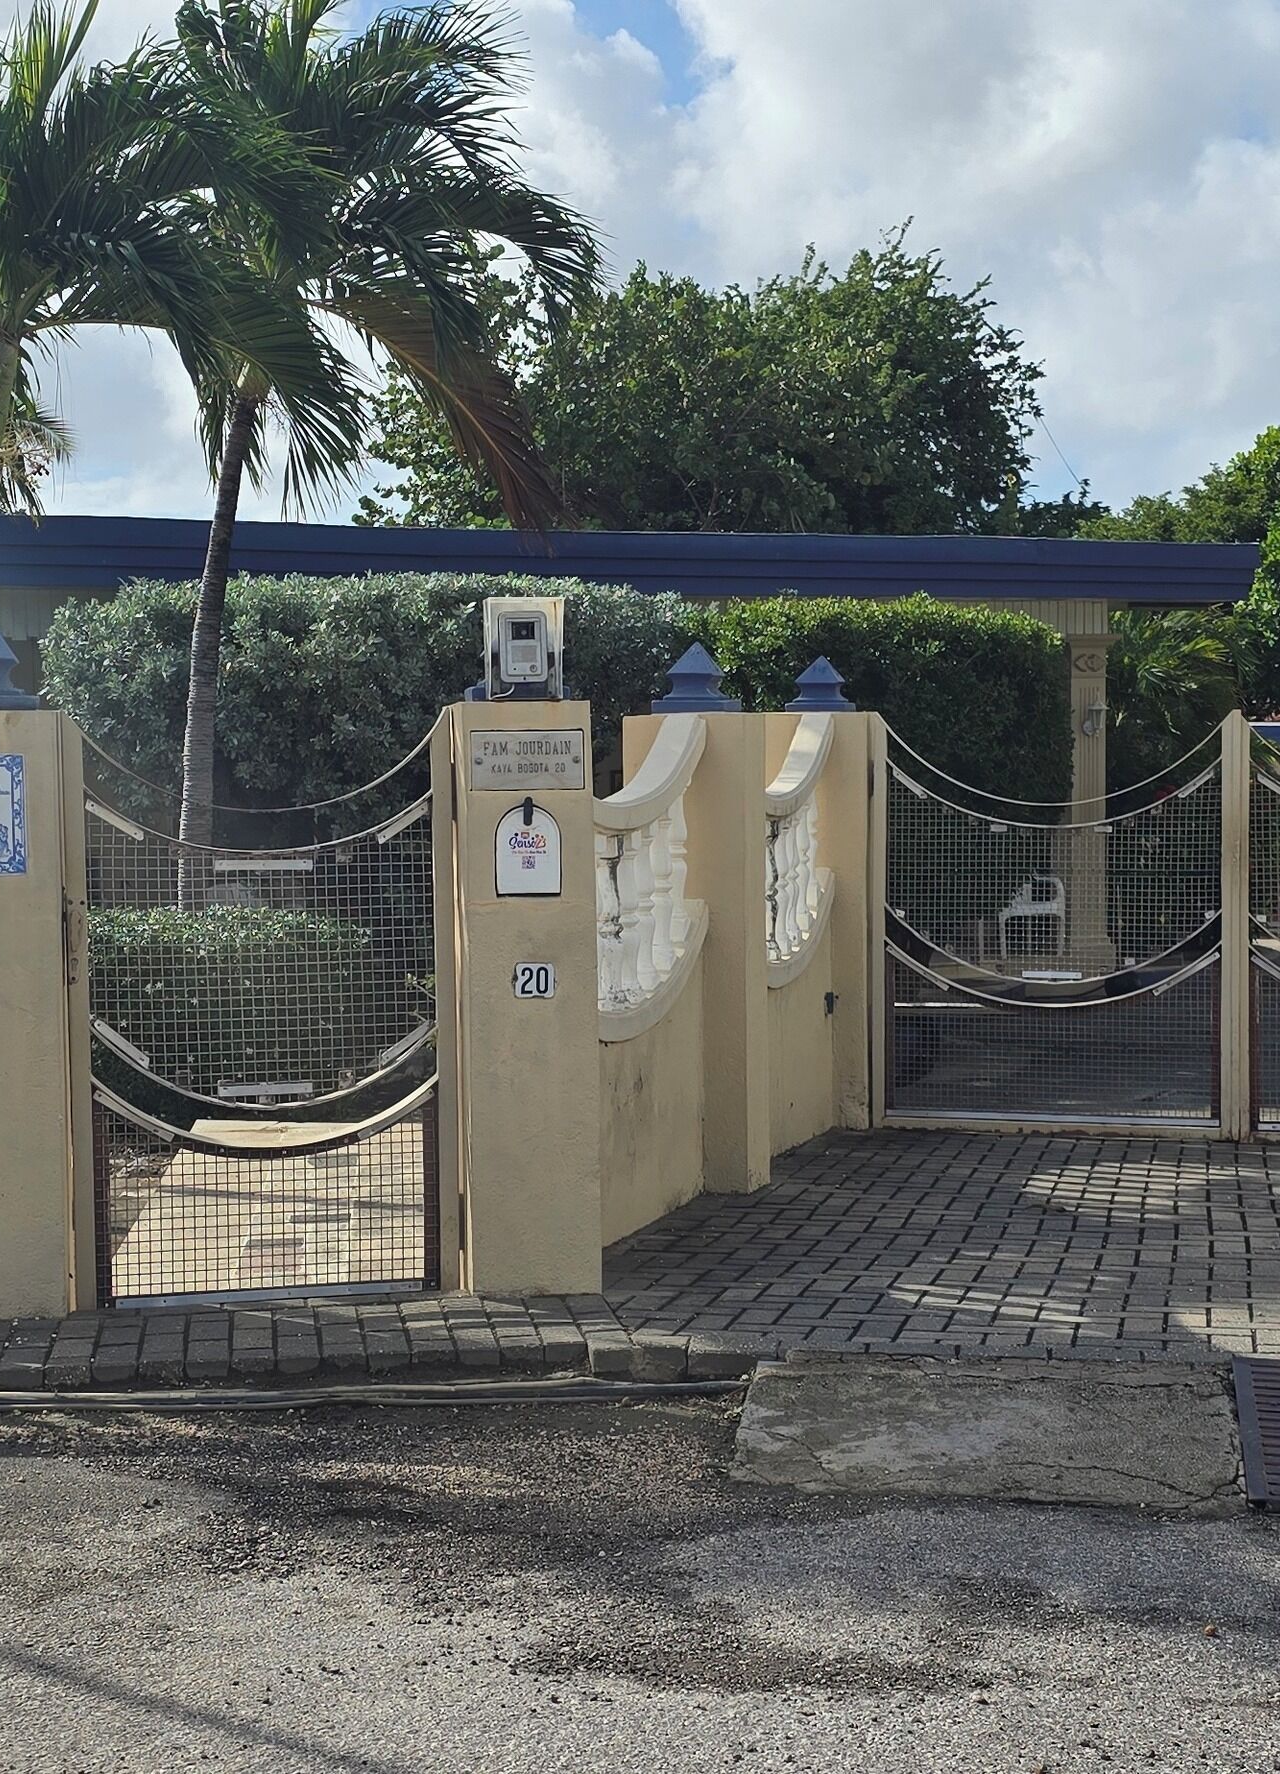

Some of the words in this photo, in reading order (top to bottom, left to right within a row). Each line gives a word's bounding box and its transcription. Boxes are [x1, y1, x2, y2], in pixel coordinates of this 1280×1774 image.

[483, 741, 509, 756] FAM
[515, 740, 572, 756] JOURDAIN
[490, 763, 513, 774] KAYA
[517, 763, 550, 774] BOGOTA
[554, 762, 566, 773] 20
[521, 966, 549, 995] 20
